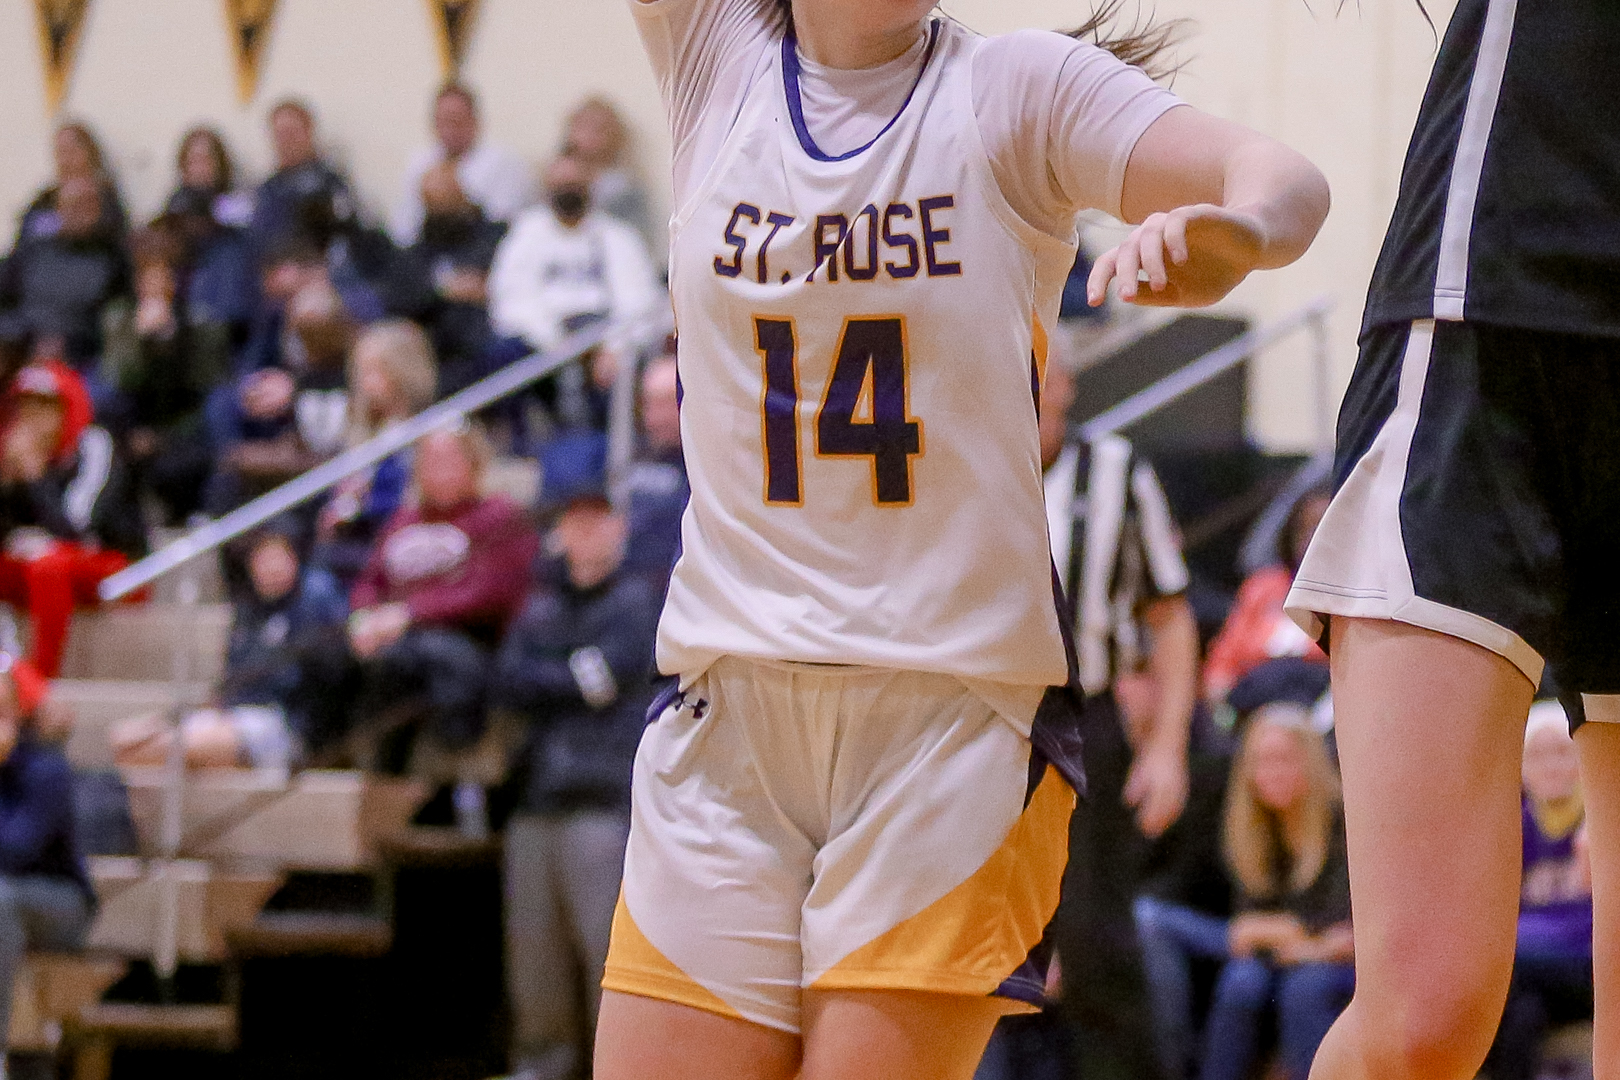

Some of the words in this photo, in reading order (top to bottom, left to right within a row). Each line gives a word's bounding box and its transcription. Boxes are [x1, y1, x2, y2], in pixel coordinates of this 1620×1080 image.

[713, 202, 798, 285] ST.
[803, 195, 964, 283] ROSE
[751, 314, 923, 507] 14
